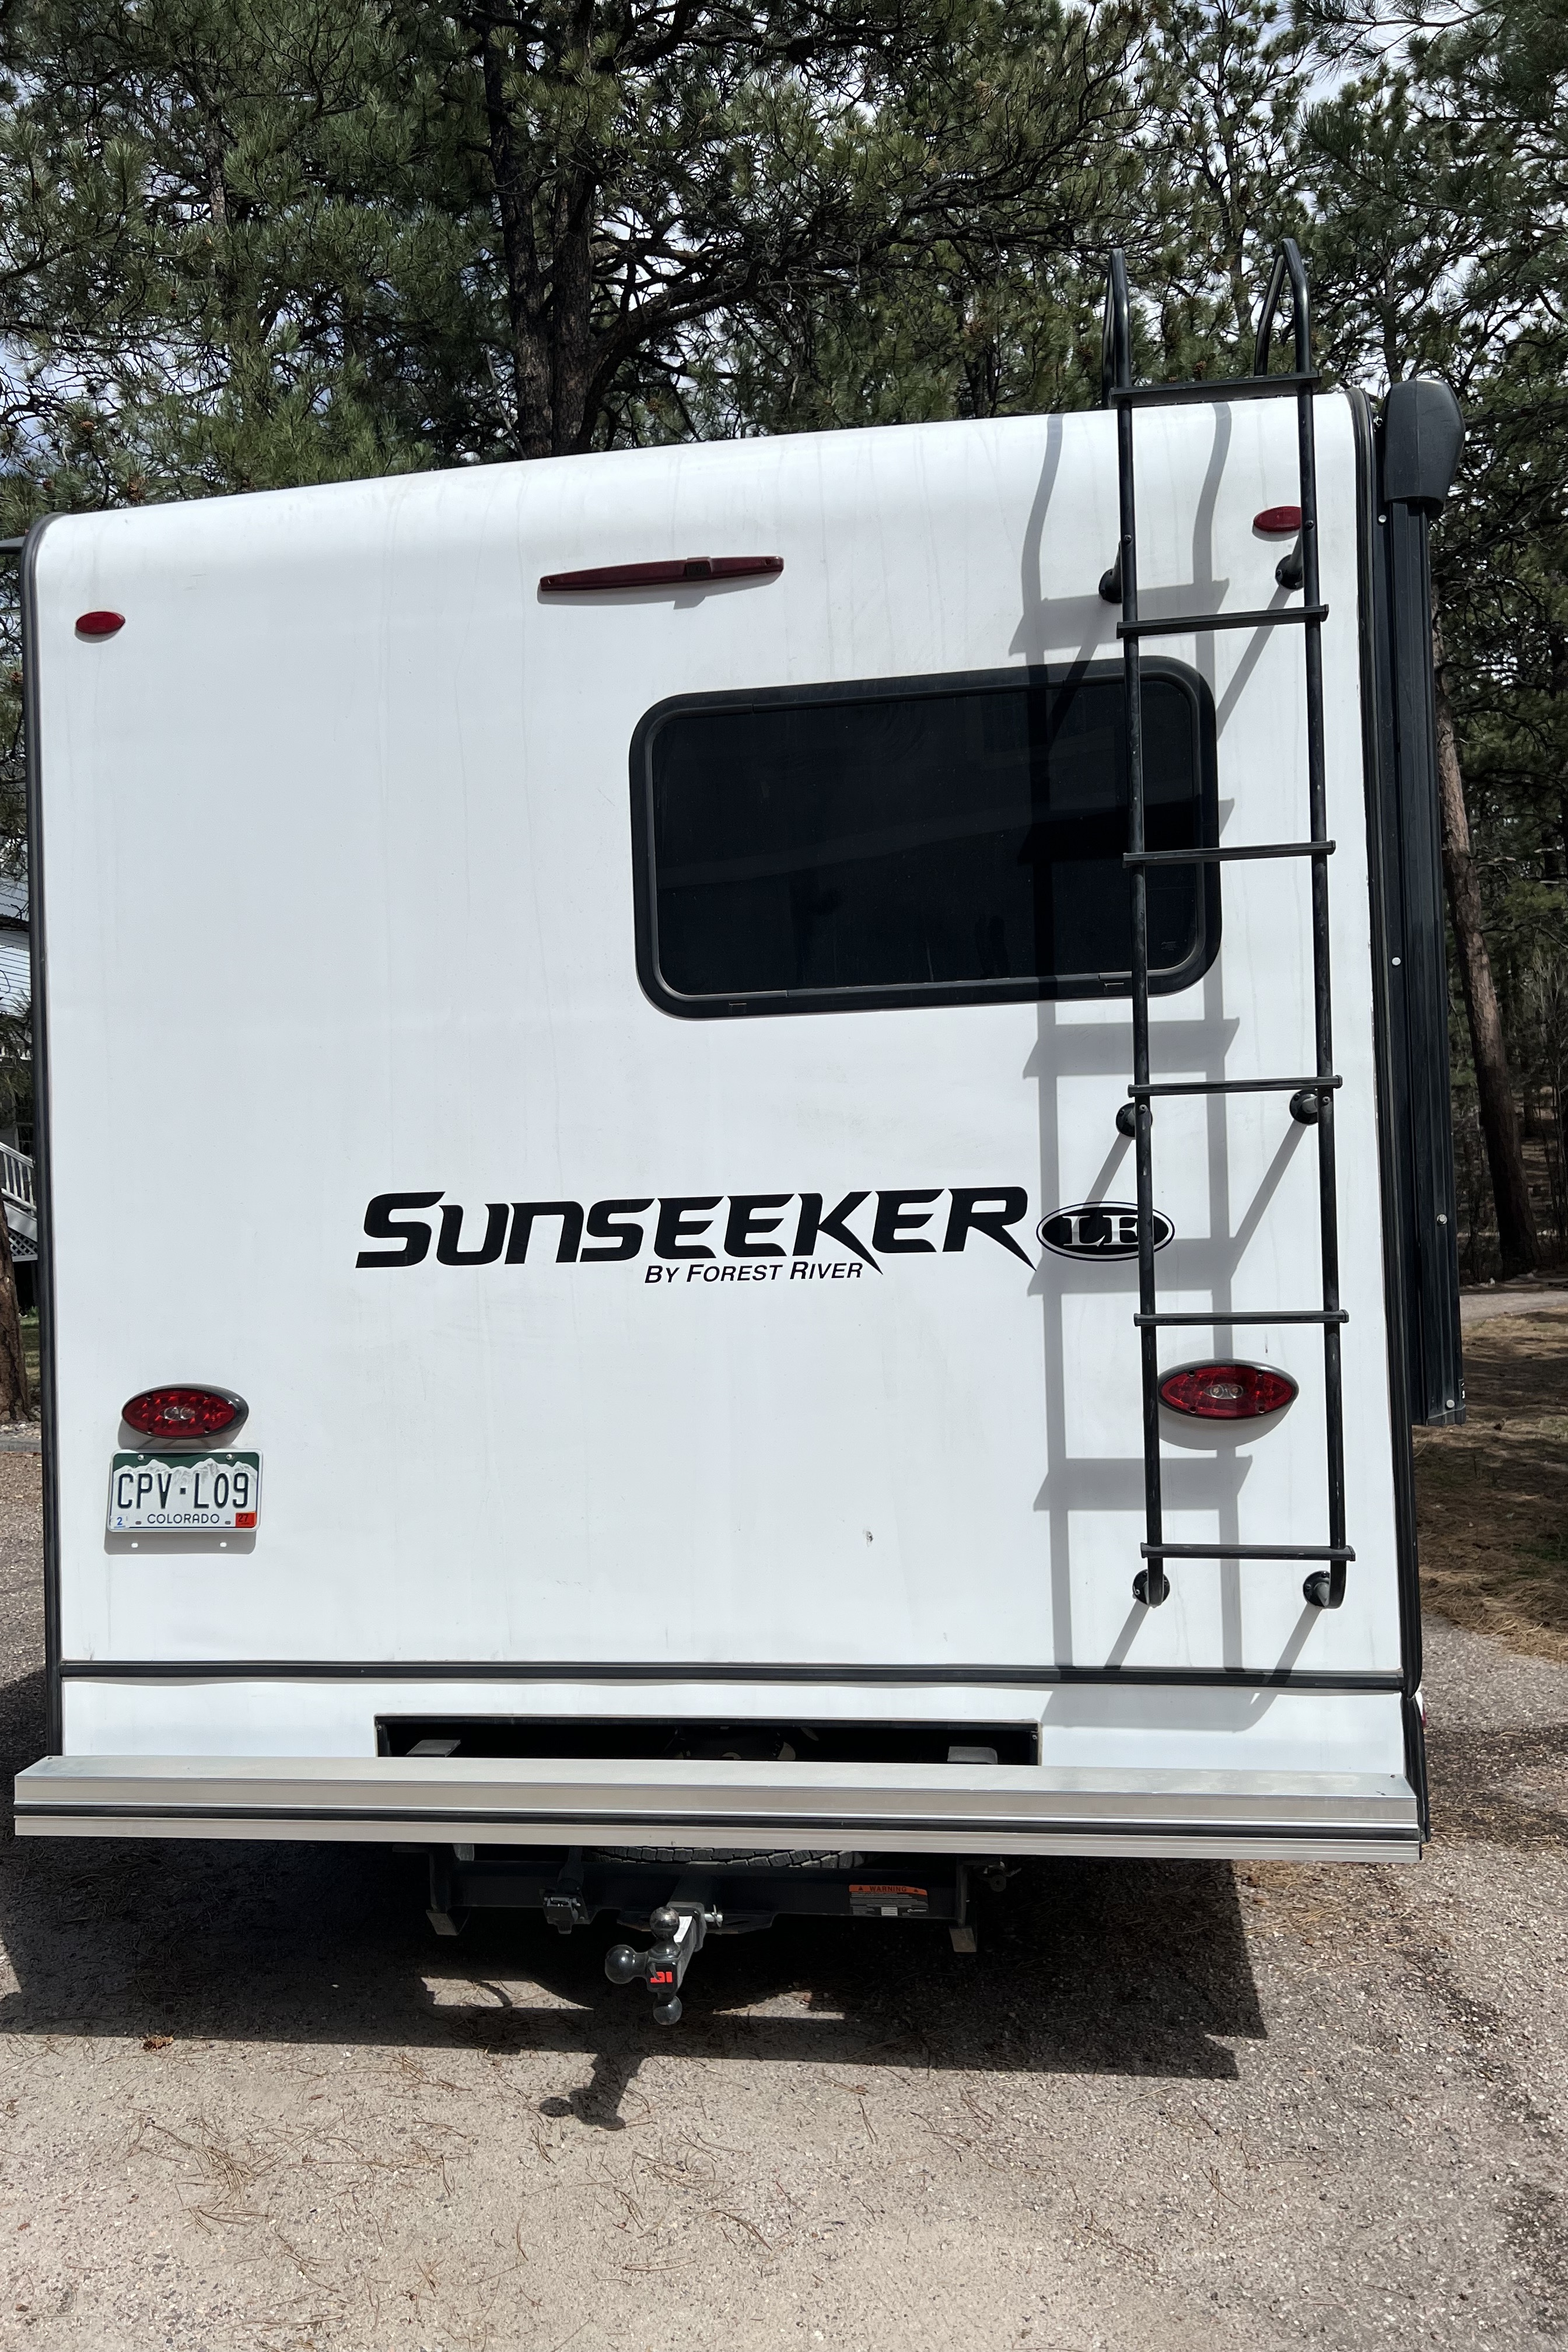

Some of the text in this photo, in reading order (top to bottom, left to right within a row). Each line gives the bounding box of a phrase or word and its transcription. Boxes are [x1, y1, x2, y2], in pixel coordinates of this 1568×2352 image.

[686, 1264, 783, 1282] FOREST
[789, 1261, 863, 1280] RIVER
[147, 1513, 220, 1524] COLORADO
